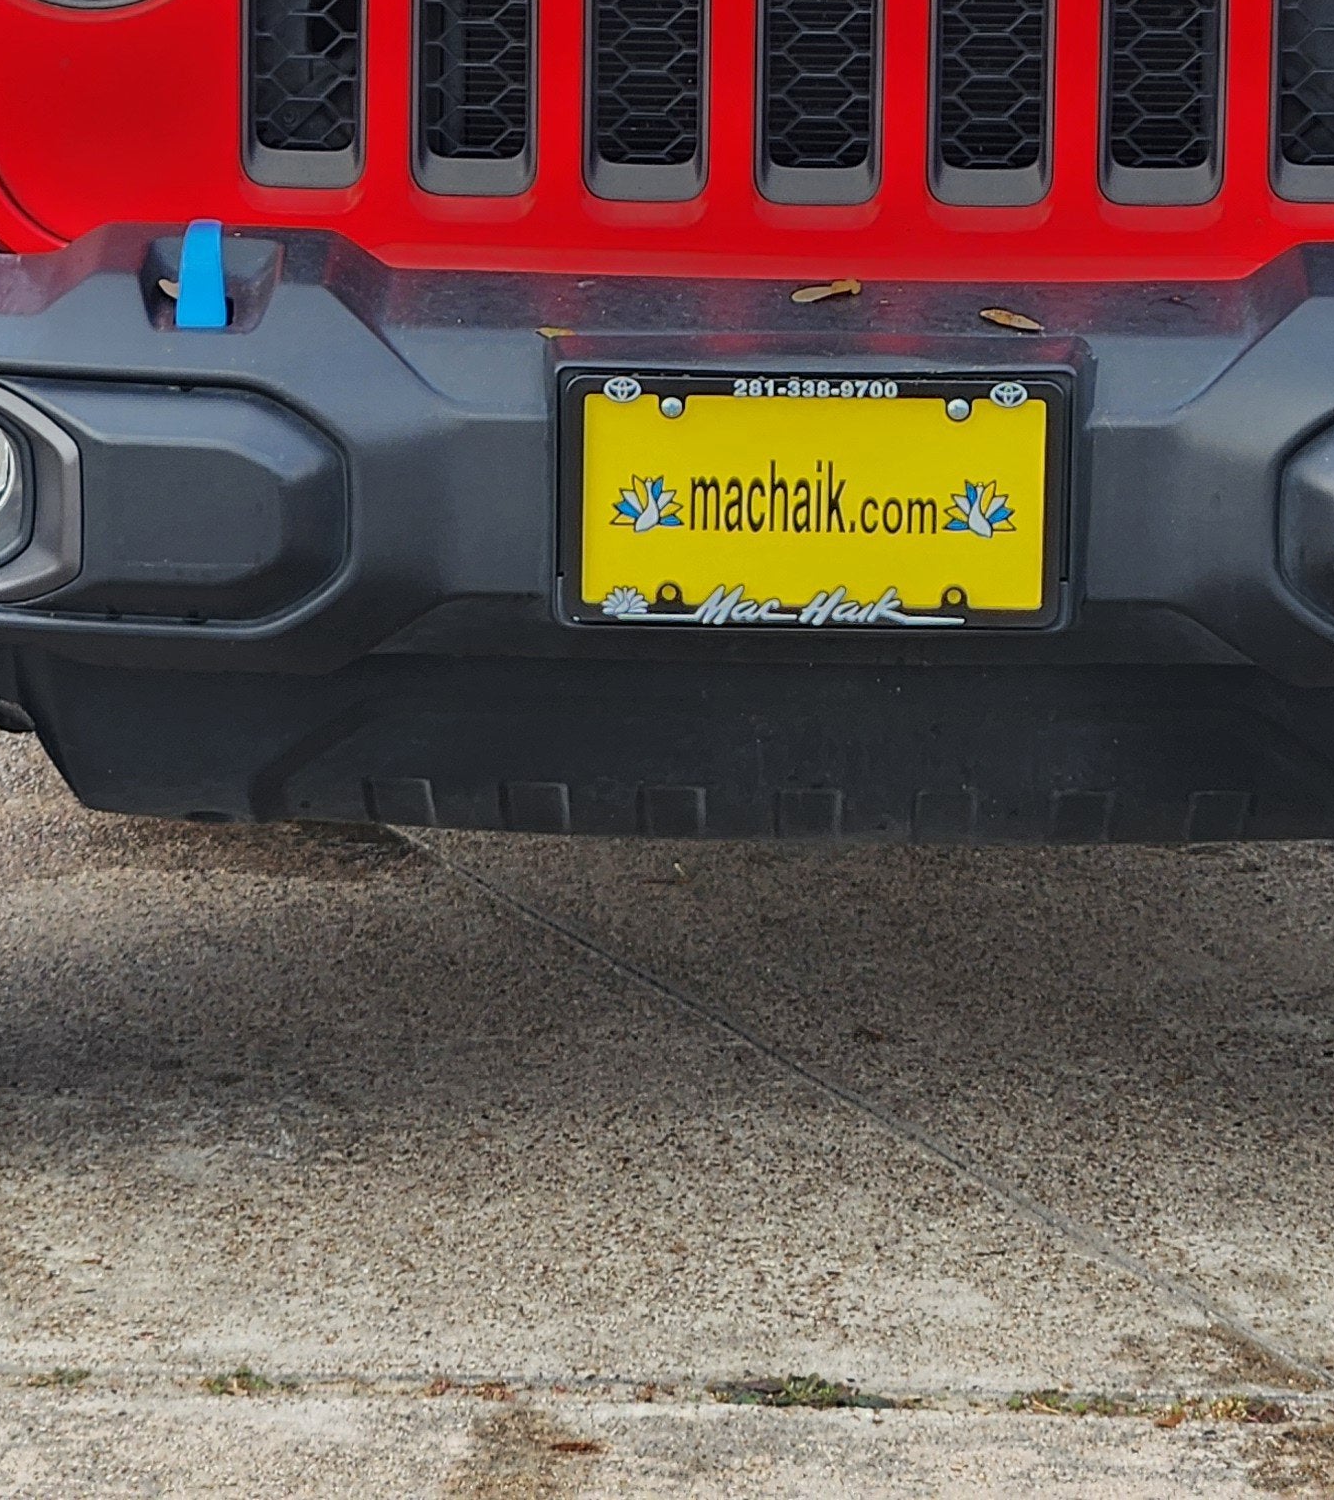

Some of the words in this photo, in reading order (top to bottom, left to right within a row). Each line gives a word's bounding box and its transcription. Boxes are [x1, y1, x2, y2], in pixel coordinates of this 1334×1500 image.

[732, 378, 899, 399] 281-338-9700
[688, 459, 938, 535] machaik.com
[695, 584, 783, 625] Mac
[798, 586, 907, 626] Haik
